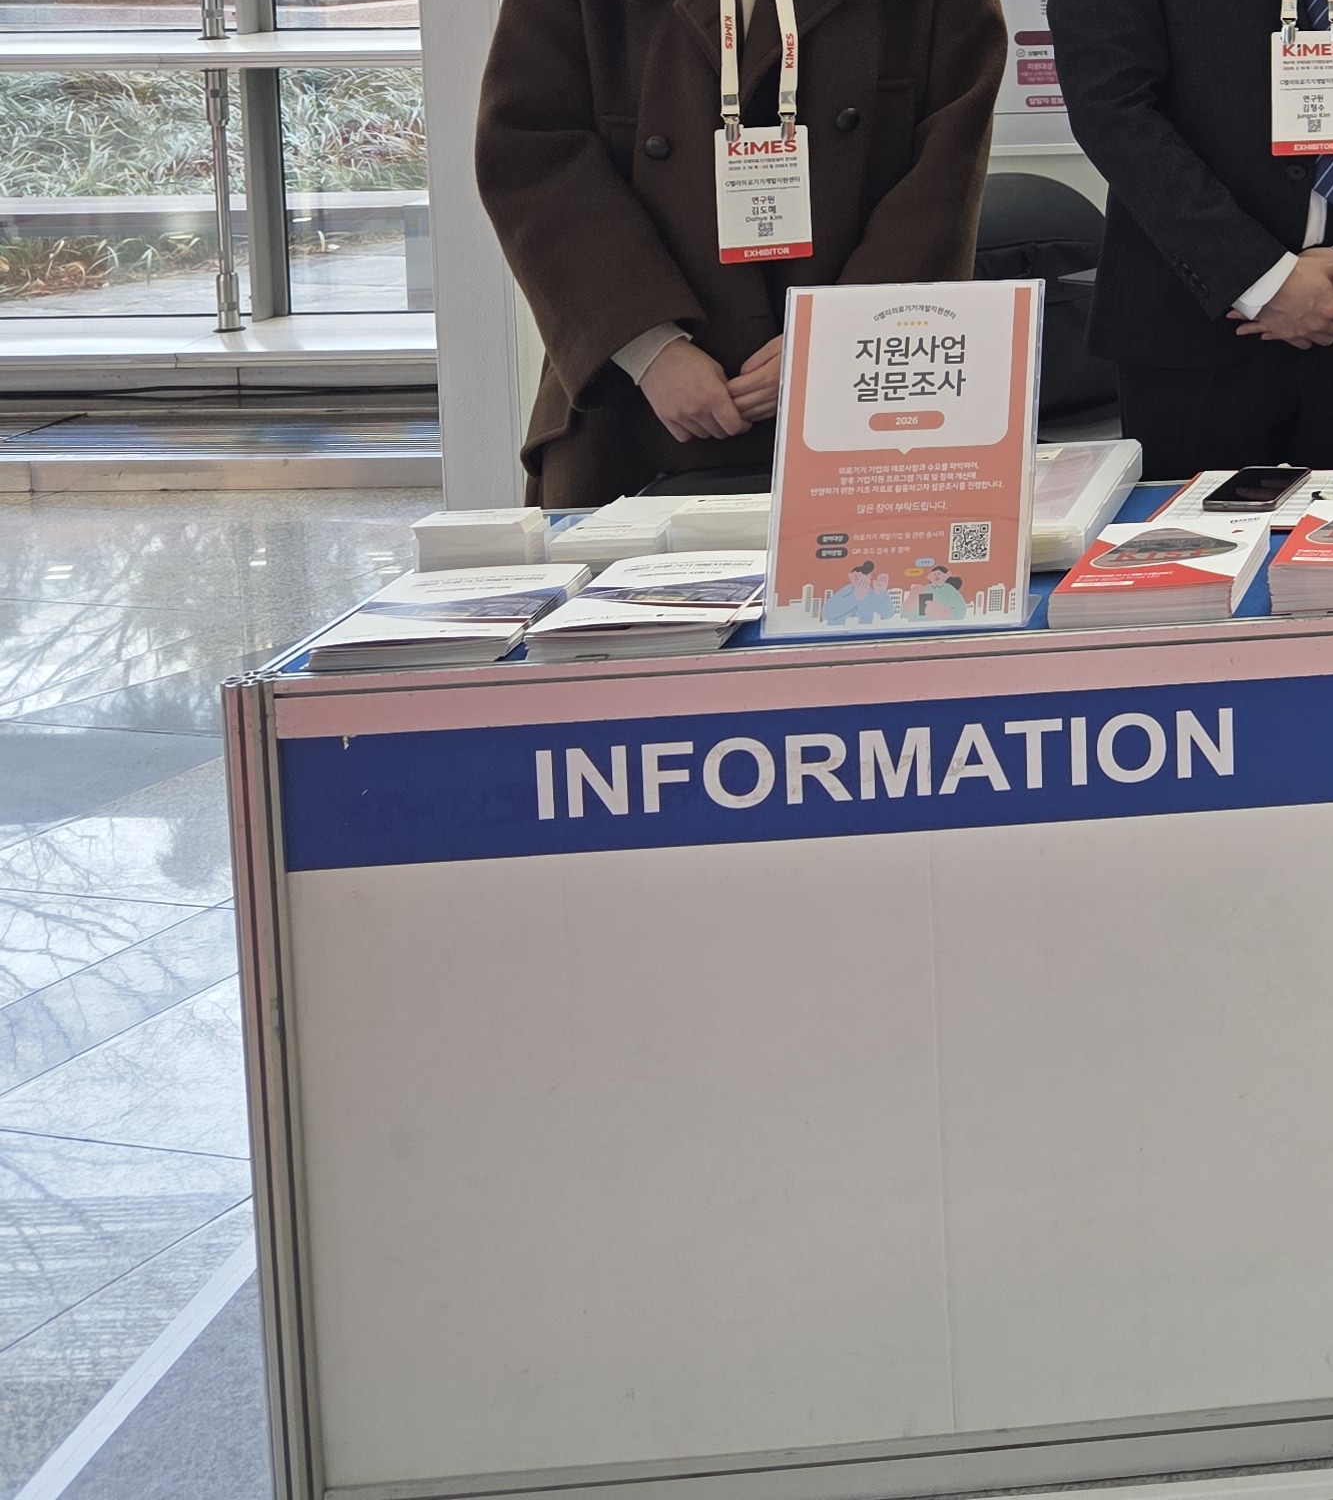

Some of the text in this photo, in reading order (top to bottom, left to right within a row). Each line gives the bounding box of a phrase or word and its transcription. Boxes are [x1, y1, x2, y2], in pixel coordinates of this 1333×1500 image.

[1302, 94, 1324, 104] 연구원
[728, 139, 797, 156] KiMES
[751, 195, 775, 205] 연구원
[744, 246, 790, 258] EXHIBITOR
[855, 334, 967, 366] 지원사업
[853, 369, 967, 403] 설문조사
[895, 415, 919, 426] 2026
[895, 501, 948, 513] 부탁드립니다.
[535, 707, 1235, 821] INFORMATION
